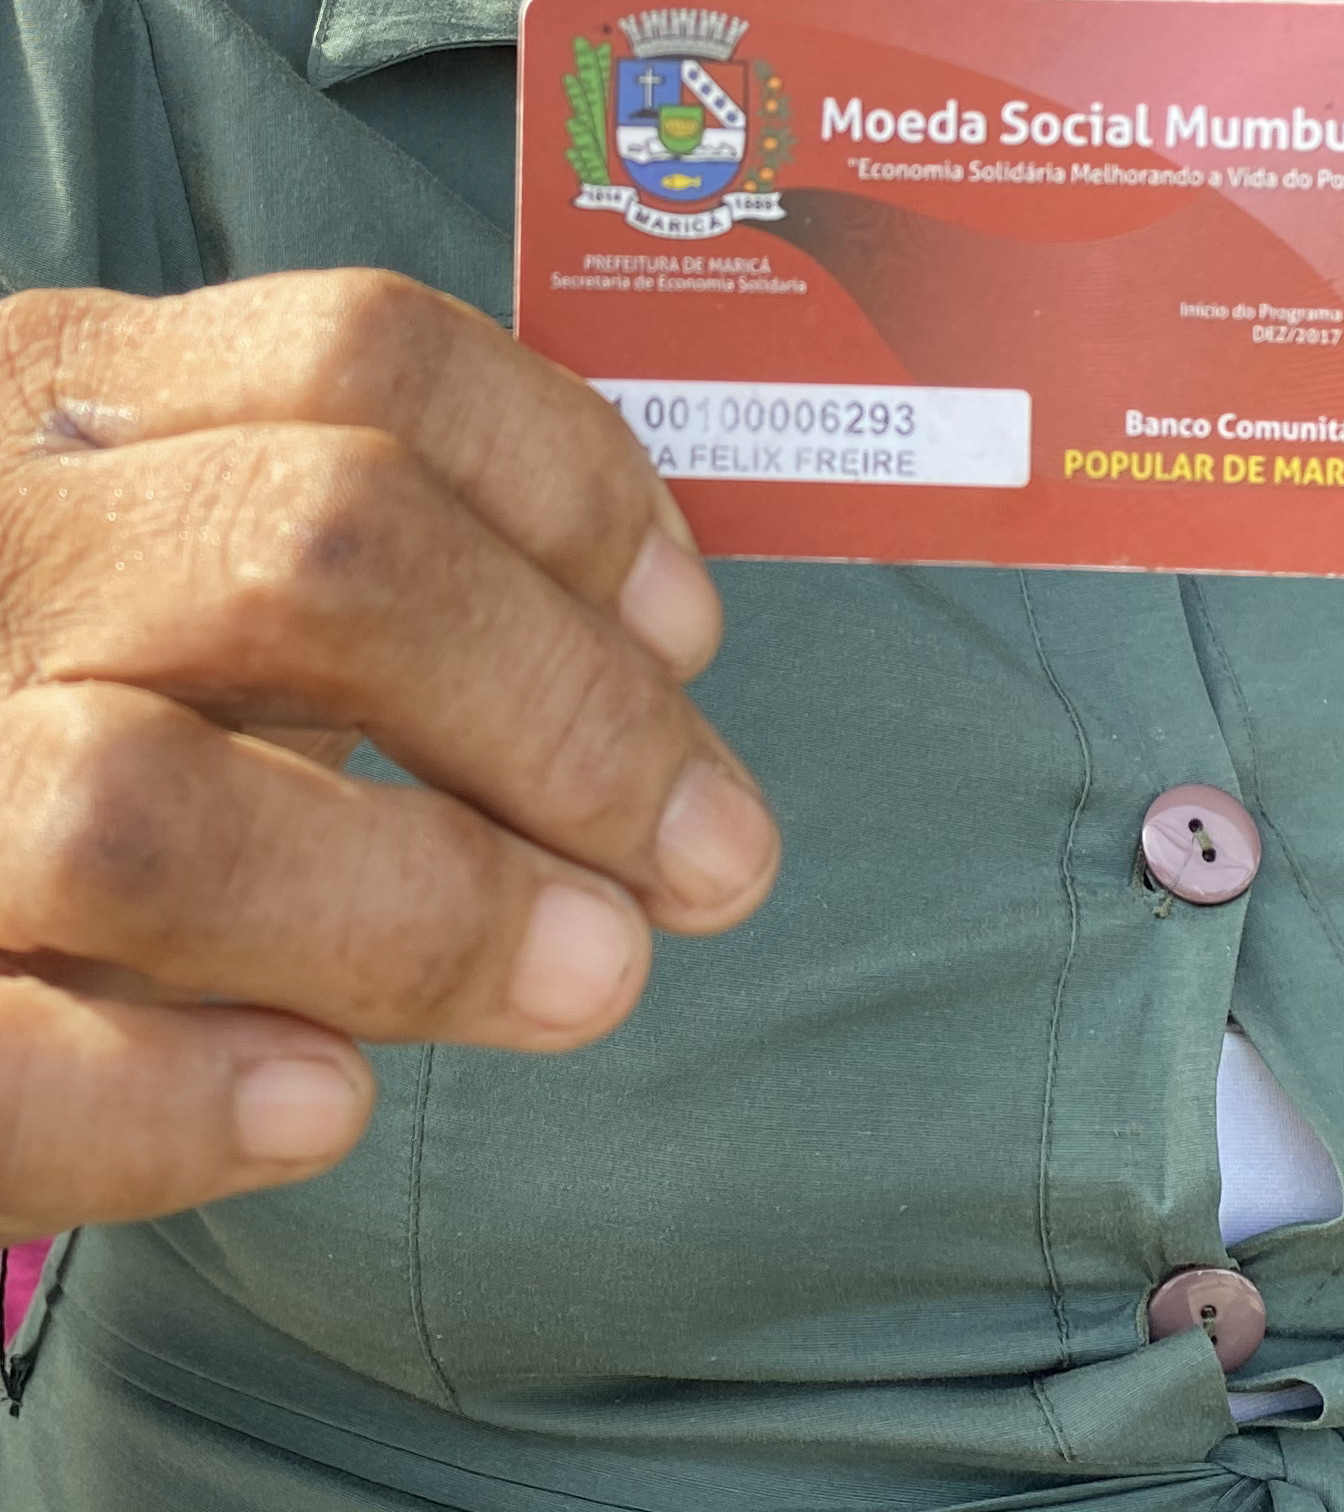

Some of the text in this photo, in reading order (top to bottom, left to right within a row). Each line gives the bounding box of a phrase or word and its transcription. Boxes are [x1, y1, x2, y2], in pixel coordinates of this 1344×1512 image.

[821, 96, 987, 143] Moeda
[1000, 101, 1153, 148] Social
[968, 159, 1065, 185] Solidária
[1071, 162, 1204, 187] Melhorando
[1208, 170, 1222, 188] a
[1227, 166, 1278, 188] Vida
[1282, 167, 1313, 189] do
[583, 254, 679, 273] PREFEITURA
[682, 256, 705, 275] DE
[551, 271, 630, 290] Secretaria
[633, 273, 654, 291] de
[657, 273, 735, 293] Economia
[1232, 303, 1256, 320] do
[1259, 303, 1344, 325] Programa
[1253, 325, 1344, 346] DEZ/2017
[644, 395, 916, 437] 00100006293
[1126, 409, 1211, 439] Banco
[690, 444, 783, 473] FELIX
[795, 446, 916, 476] FREIRE
[1064, 449, 1215, 483] POPULAR
[1223, 453, 1267, 485] DE
